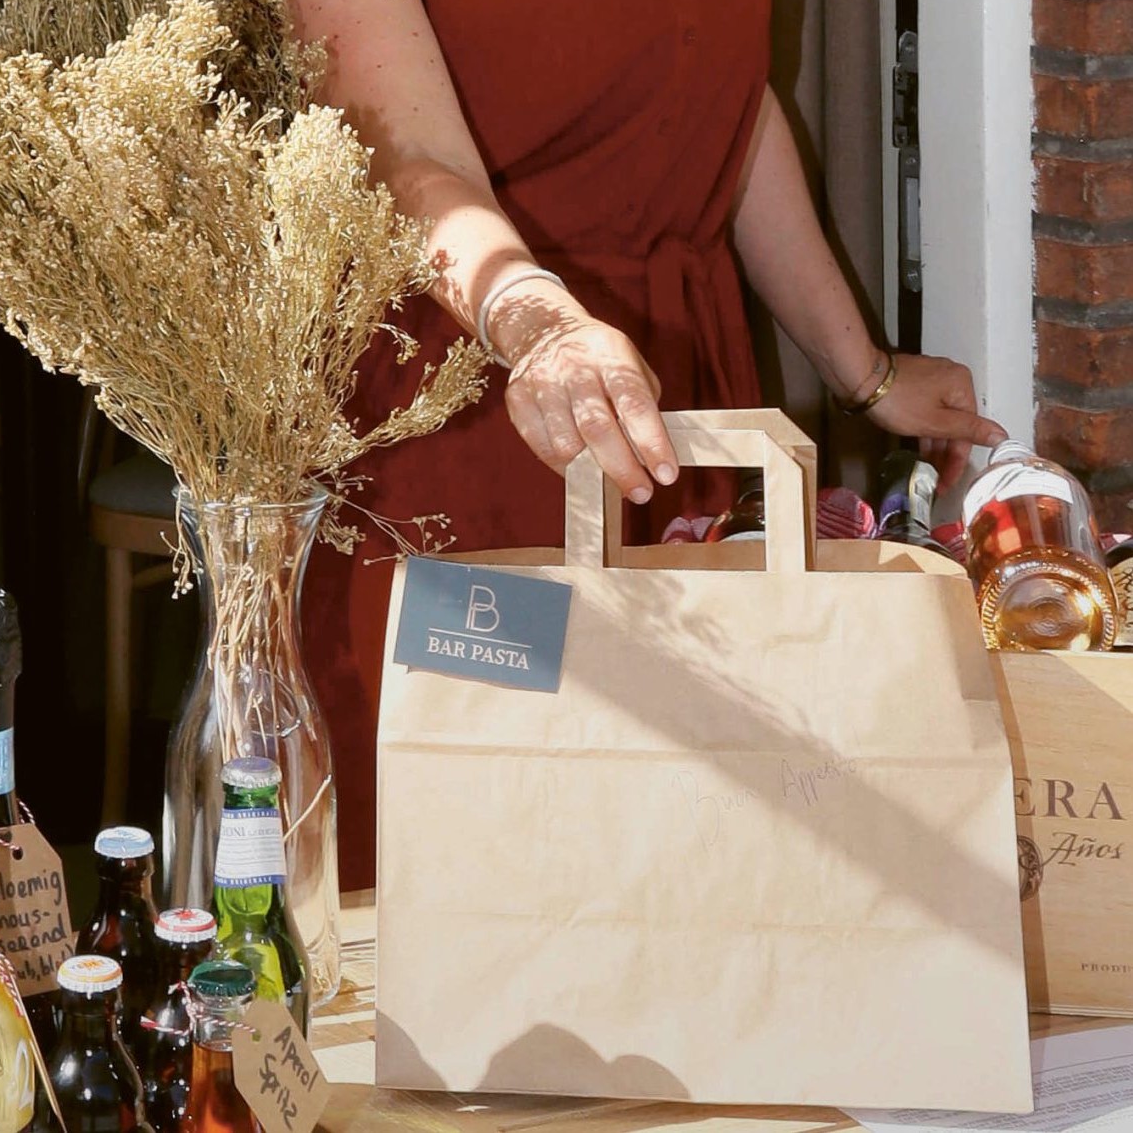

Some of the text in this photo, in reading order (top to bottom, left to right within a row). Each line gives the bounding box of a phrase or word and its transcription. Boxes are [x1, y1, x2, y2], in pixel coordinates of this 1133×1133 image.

[427, 636, 531, 671] BAR PASTA
[1017, 831, 1125, 869] Años
